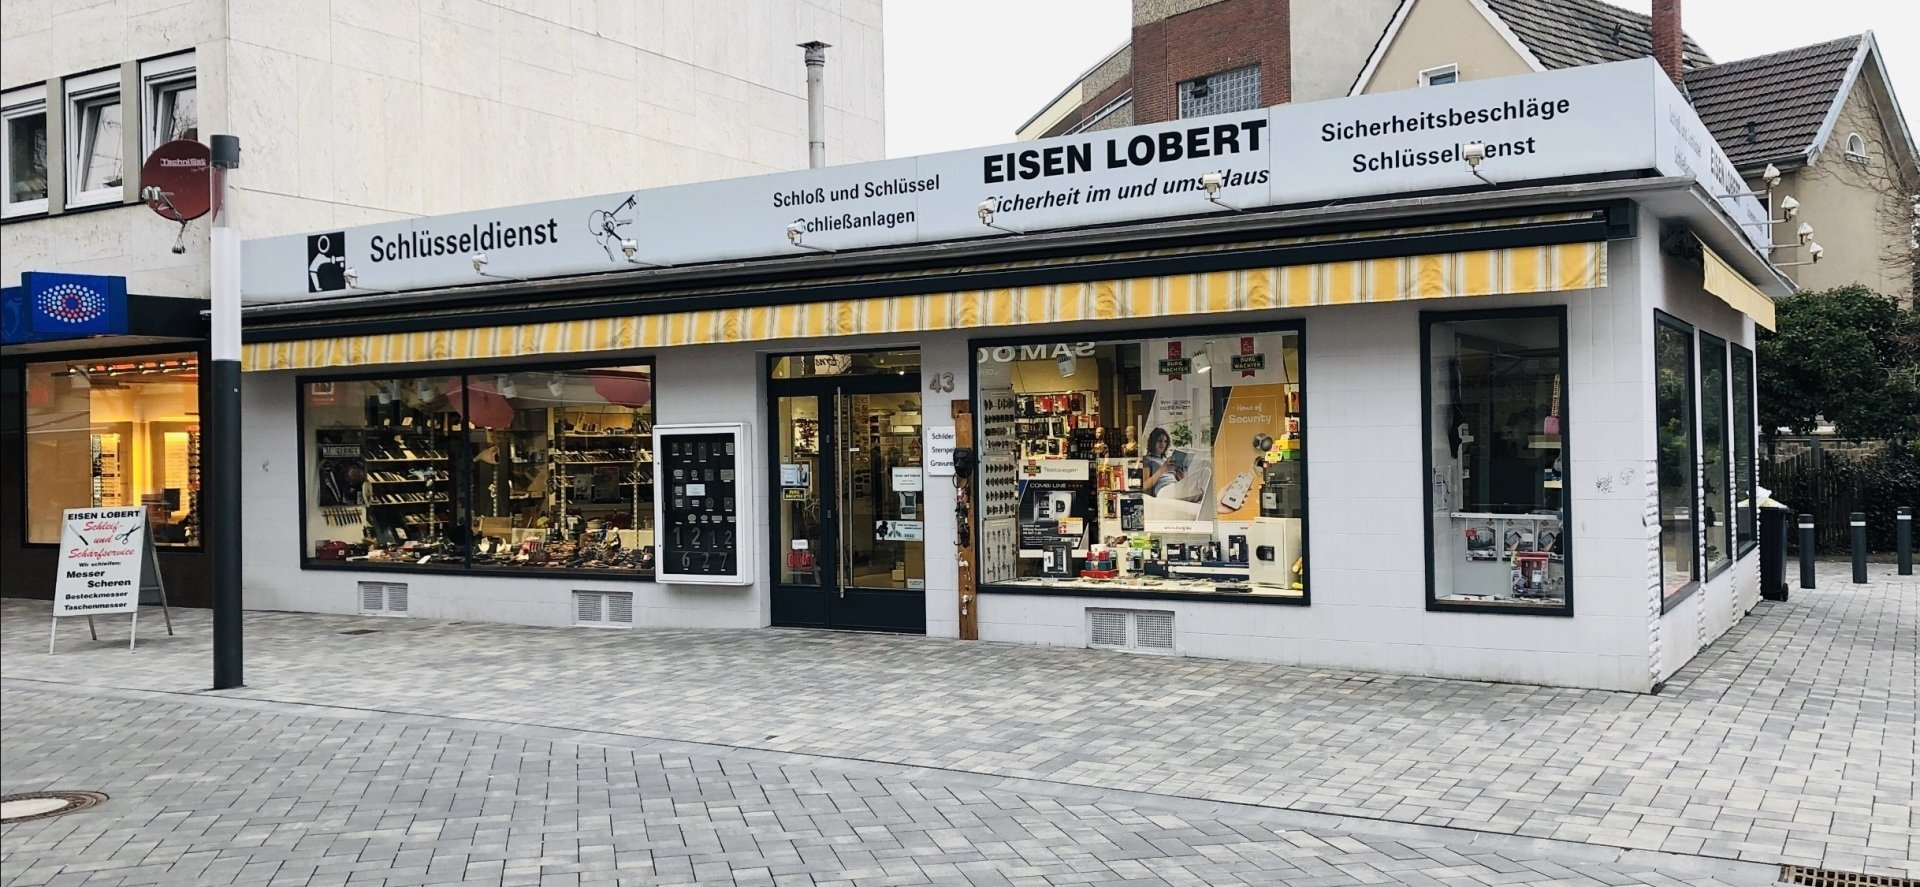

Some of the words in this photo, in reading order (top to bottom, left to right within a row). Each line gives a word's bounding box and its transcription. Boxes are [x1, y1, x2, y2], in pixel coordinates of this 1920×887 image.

[1321, 98, 1570, 143] Sicherheitsbeschläge
[984, 142, 1092, 184] EISEN
[1107, 118, 1268, 169] LOBERT
[1352, 136, 1536, 173] Schlüsselenst
[773, 187, 825, 208] Schloß
[830, 183, 859, 202] und
[864, 173, 940, 198] Schlüssel
[986, 187, 1081, 213] icherheit
[1086, 185, 1110, 203] im
[1117, 178, 1158, 200] und
[1218, 168, 1269, 188] Haus
[794, 210, 916, 234] chließanlagen
[370, 218, 558, 263] Schlüsseldienst
[929, 371, 955, 394] 43
[1228, 414, 1272, 425] Security
[931, 432, 955, 440] Schilder
[68, 512, 98, 520] EISEN
[101, 510, 140, 519] LOBERT
[93, 534, 113, 544] und
[66, 570, 105, 578] Messer
[87, 579, 131, 588] Scheren
[65, 591, 128, 600] Besteckmesser
[64, 602, 127, 611] Taschenmesser
